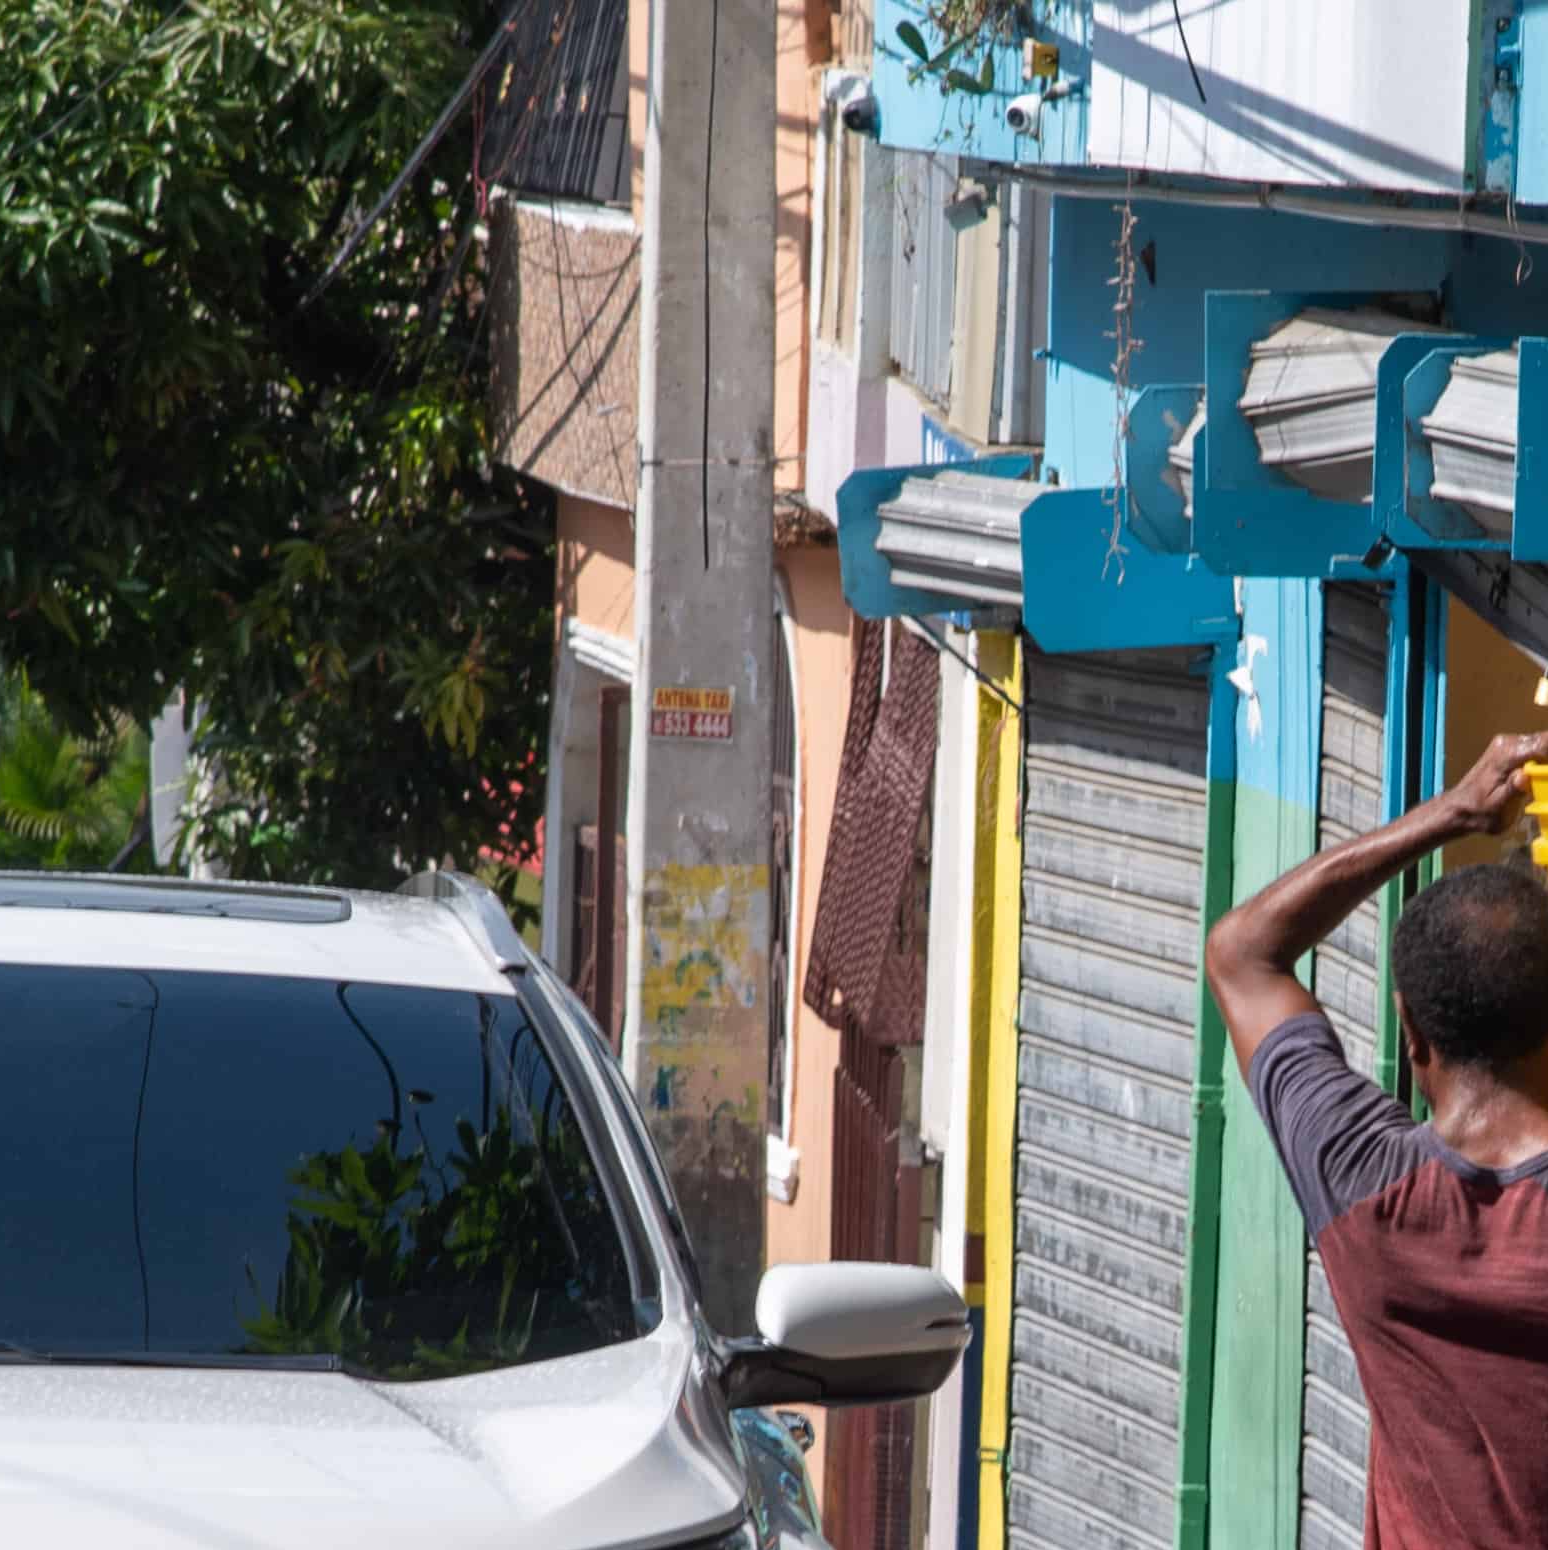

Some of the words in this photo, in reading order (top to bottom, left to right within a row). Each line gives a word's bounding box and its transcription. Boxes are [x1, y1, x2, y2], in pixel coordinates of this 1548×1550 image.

[655, 690, 701, 708] ANTENA
[704, 690, 730, 709] TAXI
[664, 712, 690, 735] 533
[694, 713, 729, 736] 4444
